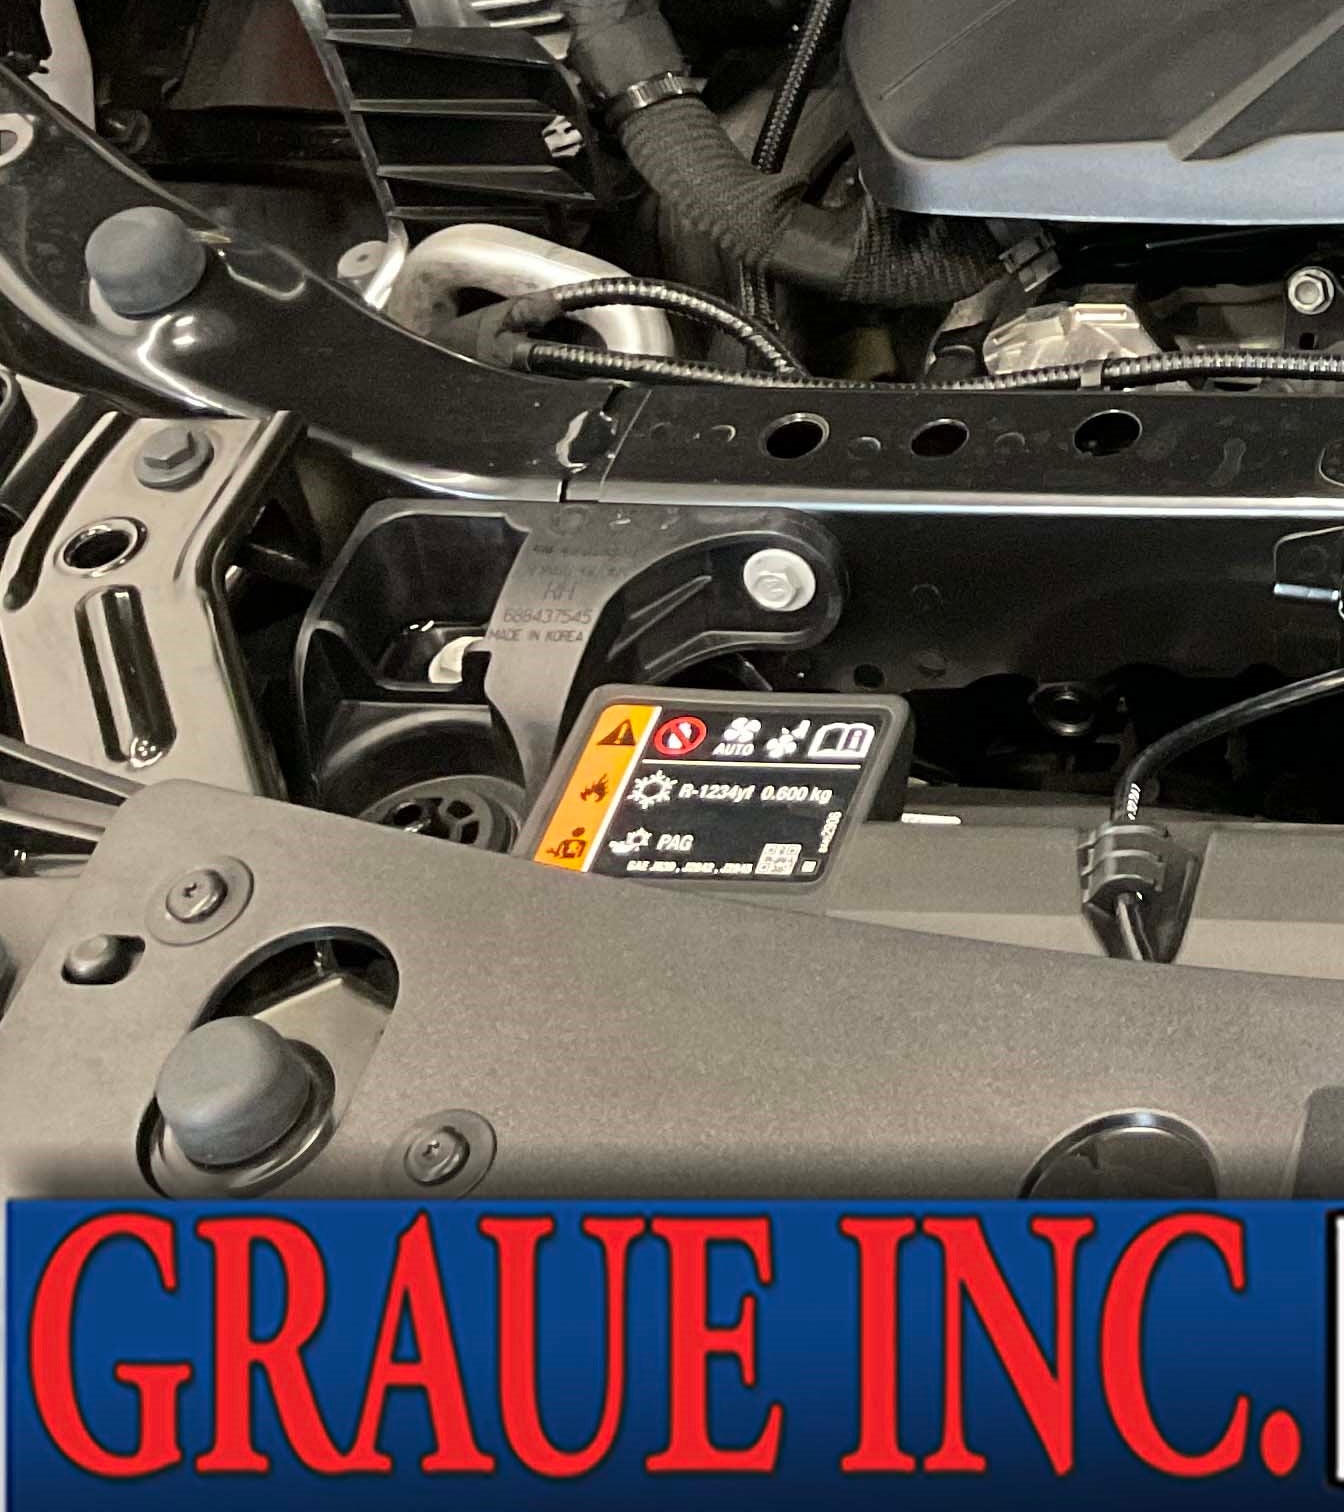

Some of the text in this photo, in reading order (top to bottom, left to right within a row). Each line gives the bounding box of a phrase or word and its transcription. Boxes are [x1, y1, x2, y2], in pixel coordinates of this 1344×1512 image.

[528, 630, 540, 641] IN
[545, 630, 585, 642] KOREA
[712, 743, 755, 757] AUTO
[760, 784, 808, 801] 0.600
[809, 785, 833, 805] kg
[655, 834, 695, 851] PAG
